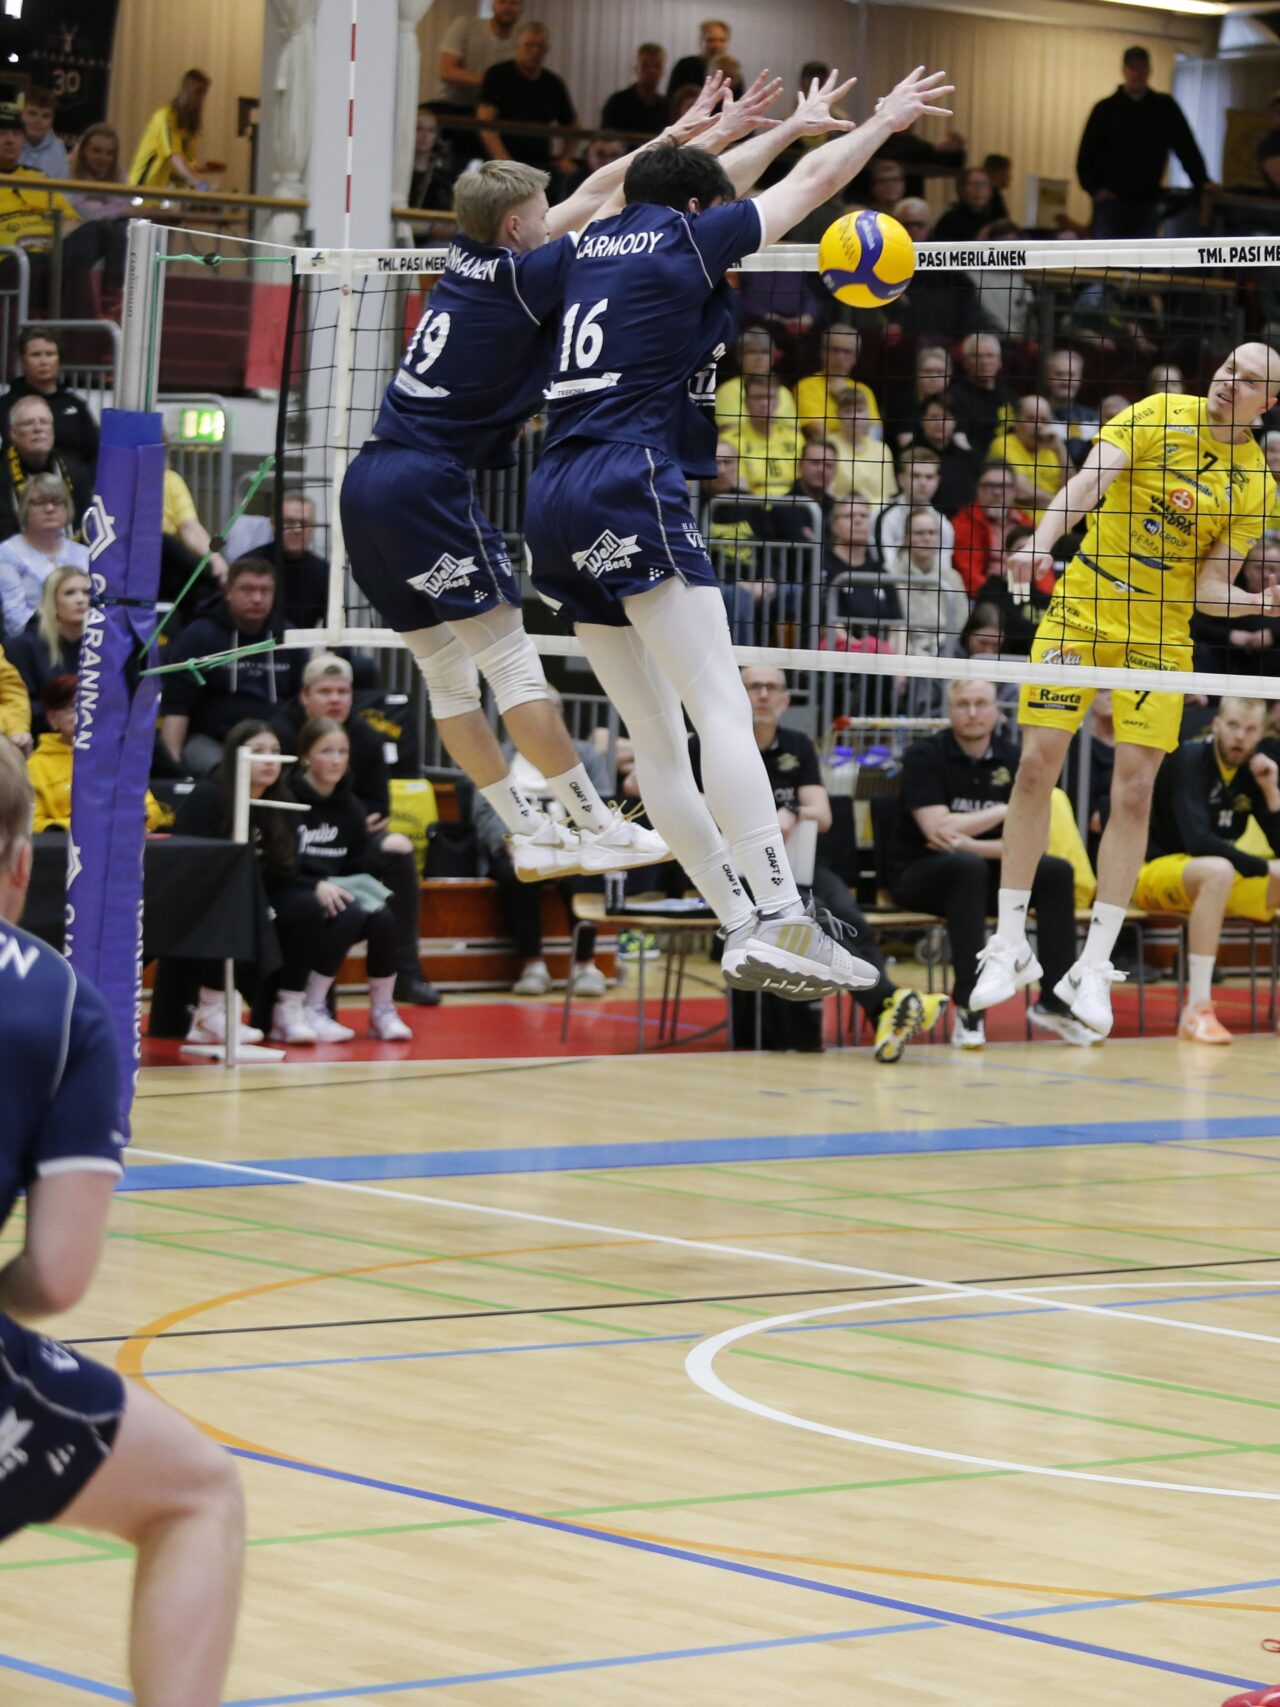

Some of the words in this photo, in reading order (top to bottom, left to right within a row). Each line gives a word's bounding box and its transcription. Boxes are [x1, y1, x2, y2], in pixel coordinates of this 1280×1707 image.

[401, 257, 423, 271] PASI
[918, 251, 947, 267] PASI
[950, 247, 1026, 267] MERILÄINEN
[1198, 247, 1227, 264] TMI.
[1230, 246, 1261, 263] PASI
[404, 308, 451, 375] 19
[559, 298, 609, 371] 16
[1198, 451, 1219, 474] 7
[586, 536, 618, 571] Well
[603, 553, 632, 572] Beef
[424, 560, 456, 593] Well
[1039, 688, 1082, 704] Rauta
[569, 781, 588, 803] CRAFT
[765, 846, 782, 875] CRAFT
[722, 863, 739, 887] CRAFT
